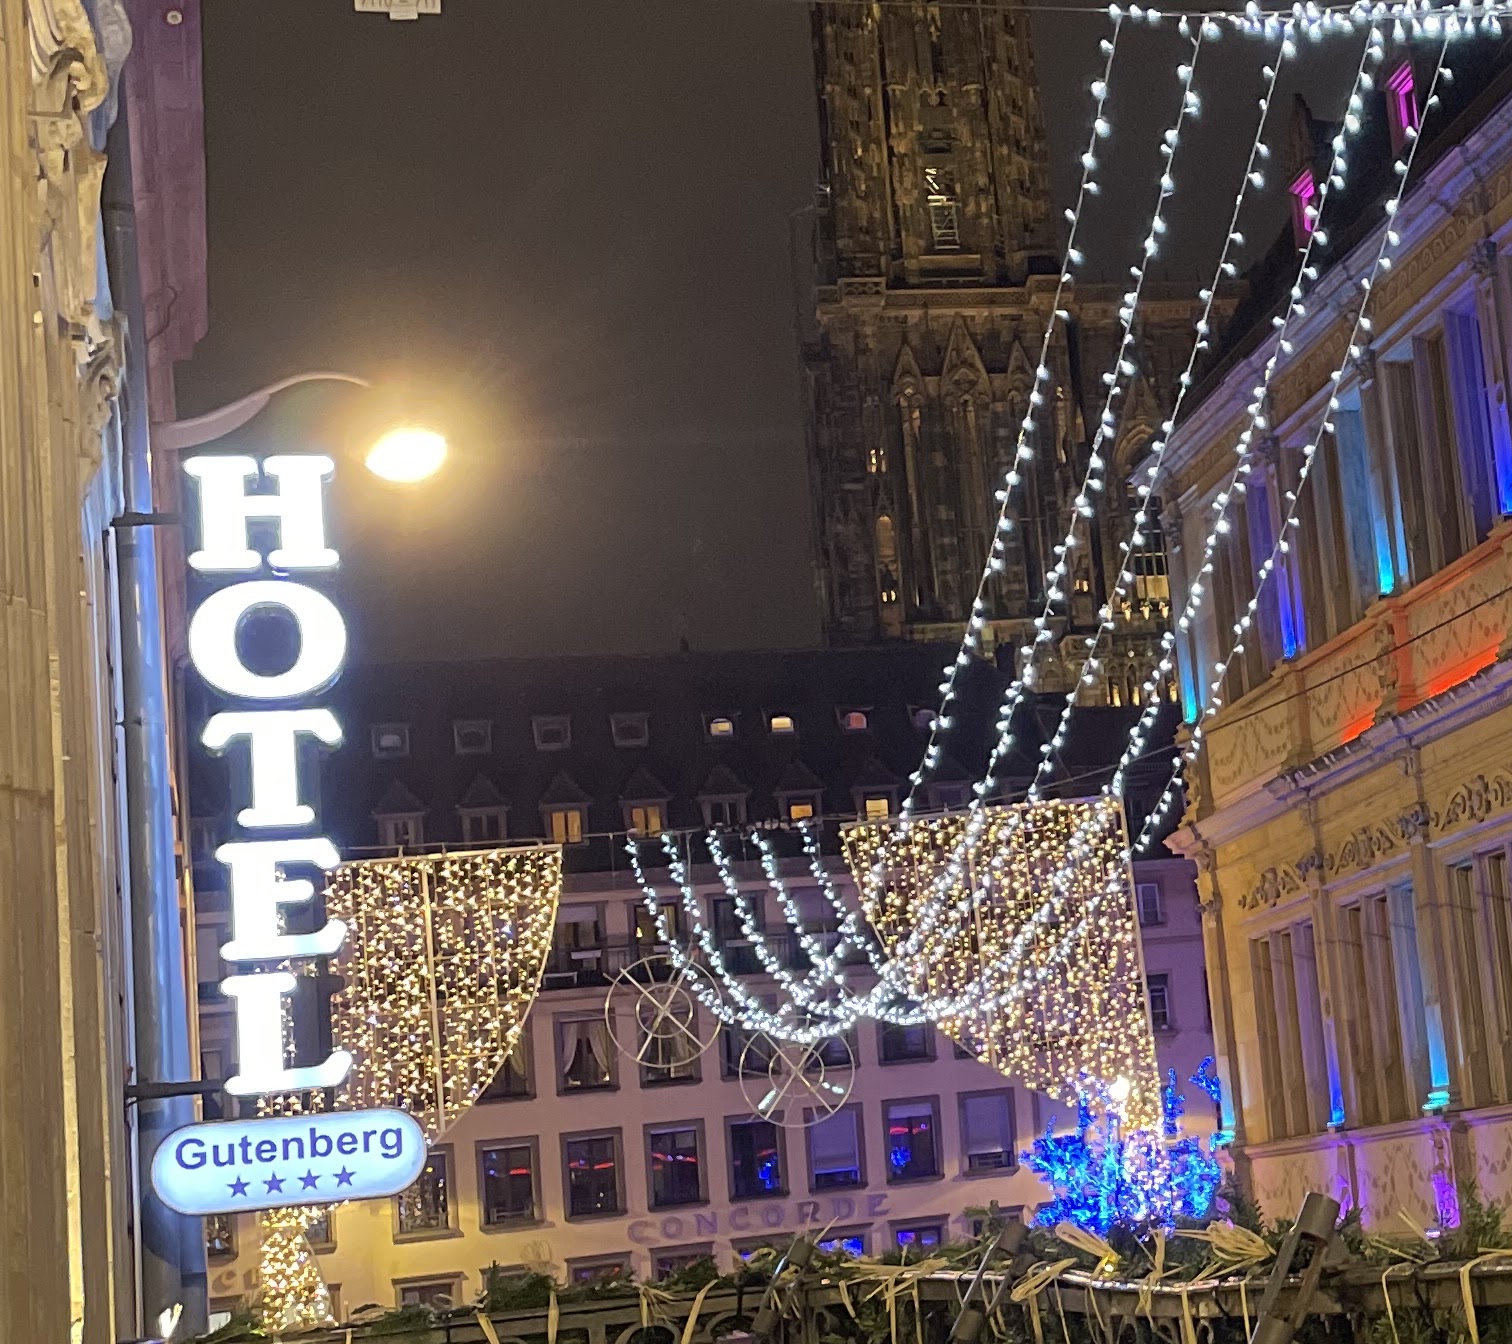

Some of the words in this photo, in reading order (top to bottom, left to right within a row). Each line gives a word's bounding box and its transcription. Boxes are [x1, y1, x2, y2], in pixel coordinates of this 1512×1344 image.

[183, 455, 353, 1097] HOTEL
[175, 1127, 403, 1170] Gutenberg
[627, 1194, 890, 1244] CONCORDE
